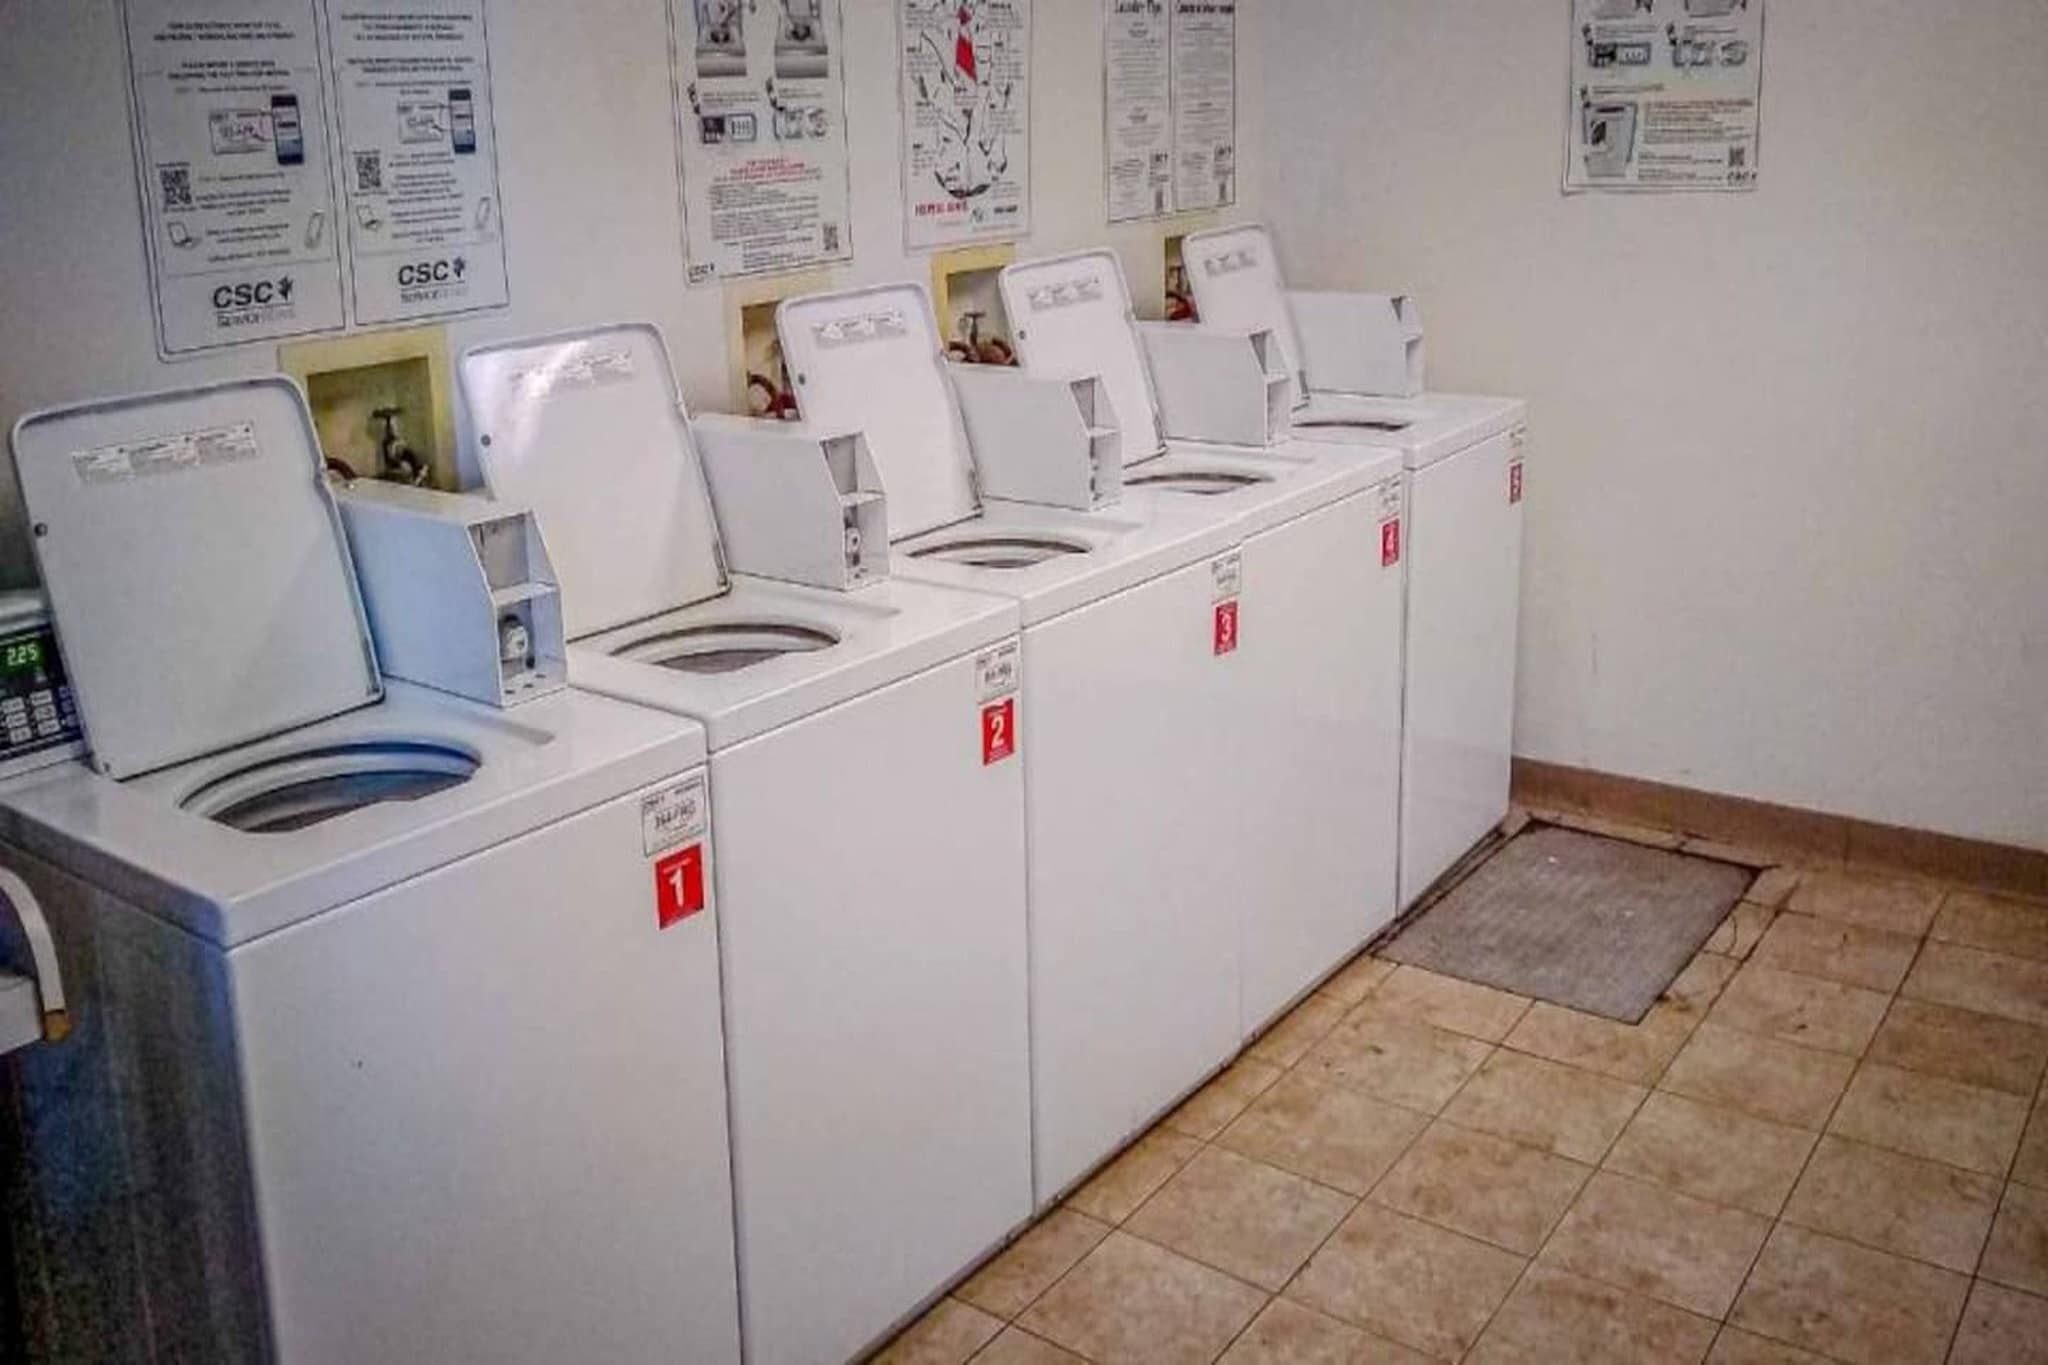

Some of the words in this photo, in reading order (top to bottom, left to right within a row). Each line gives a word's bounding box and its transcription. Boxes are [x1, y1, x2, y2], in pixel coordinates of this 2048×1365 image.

[398, 260, 450, 286] CSC
[213, 279, 274, 309] CSC
[1221, 613, 1233, 642] 3
[990, 713, 1005, 749] 2
[668, 865, 685, 908] 1
